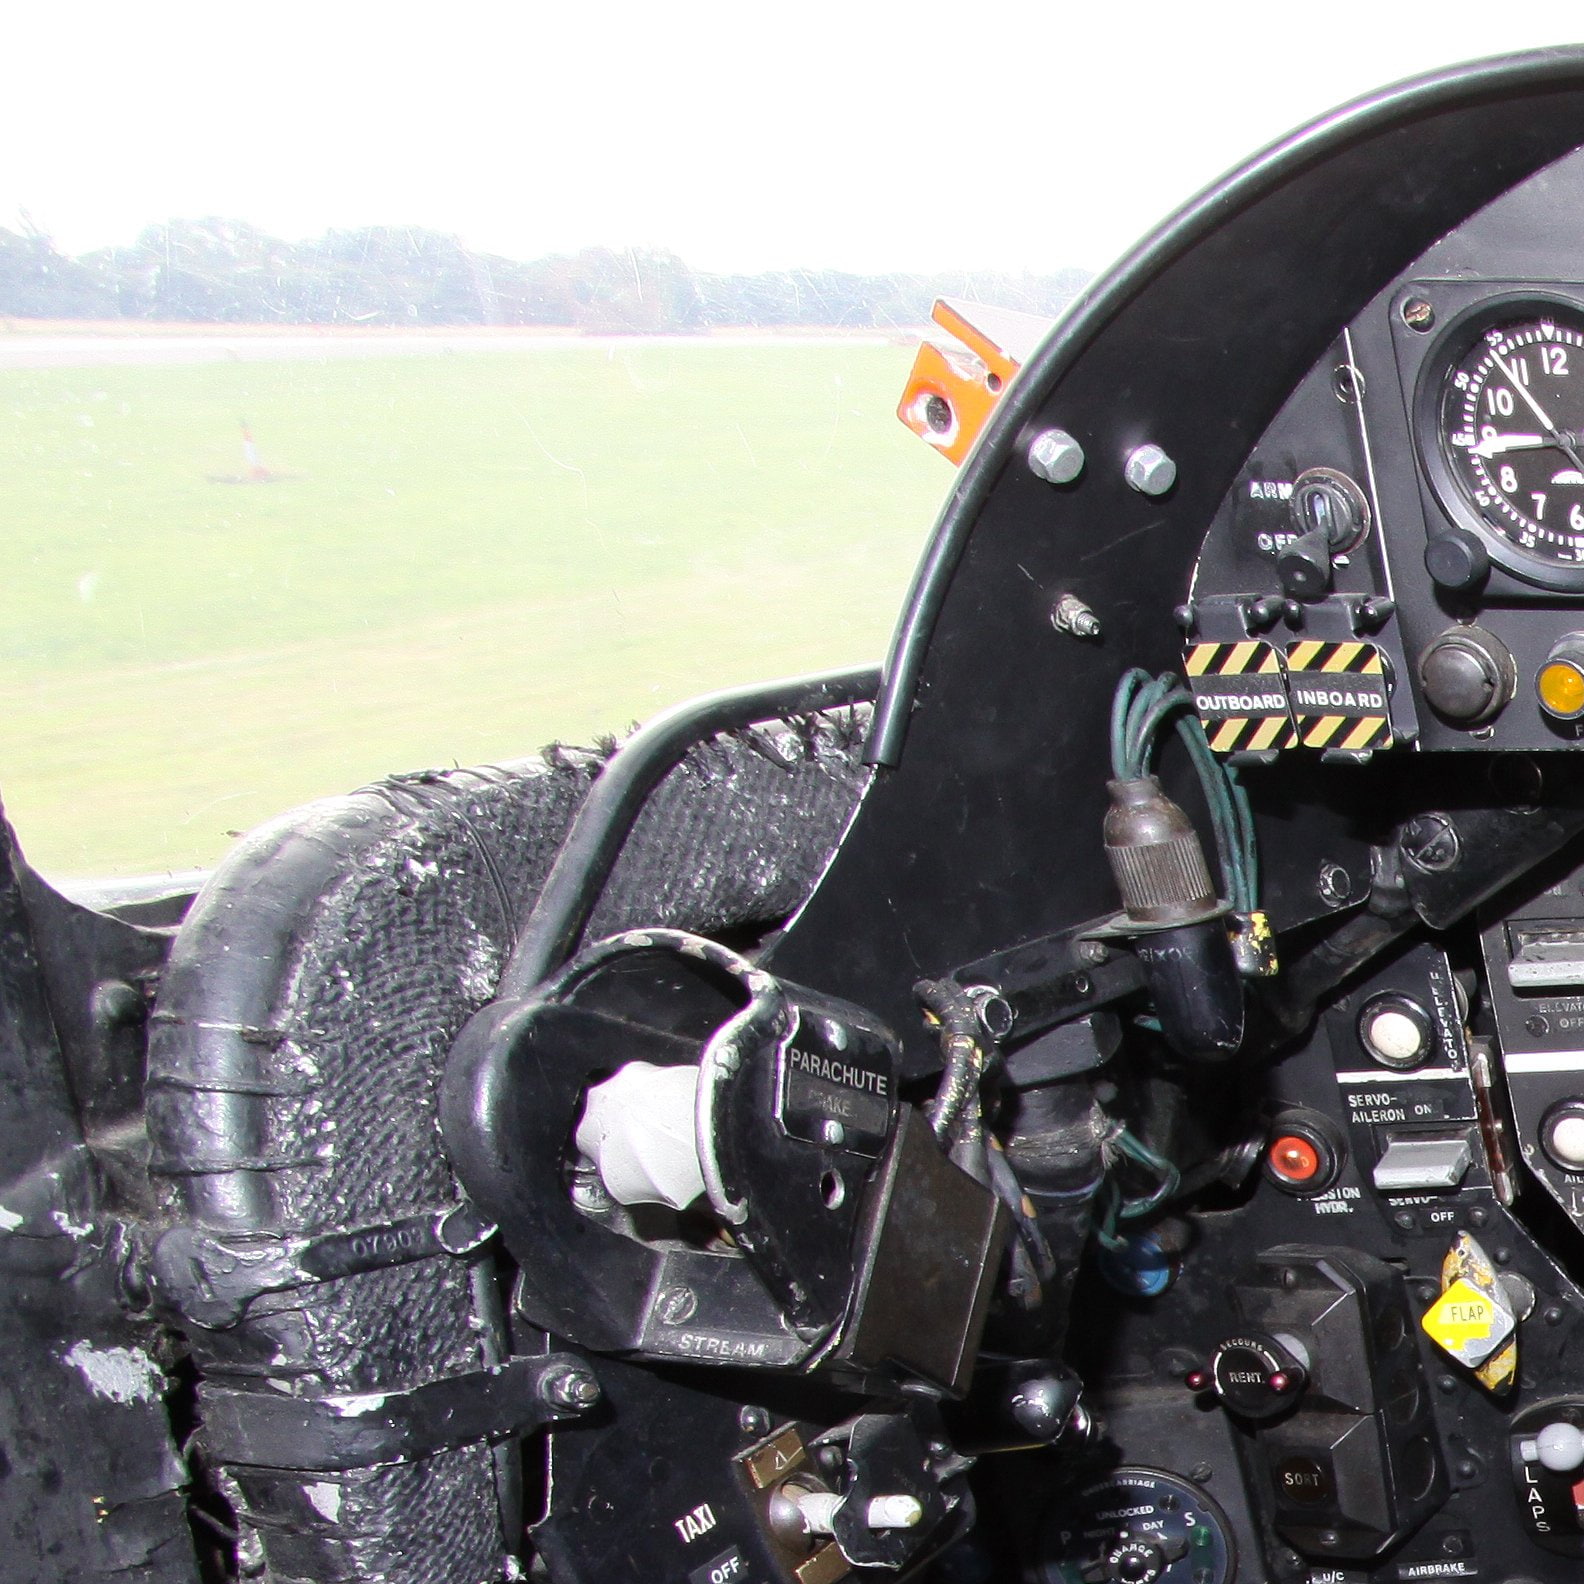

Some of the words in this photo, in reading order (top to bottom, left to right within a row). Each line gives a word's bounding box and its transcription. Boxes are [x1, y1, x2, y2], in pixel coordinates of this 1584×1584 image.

[1195, 693, 1287, 711] OUTBOARD
[1296, 690, 1383, 710] INBOARD
[789, 1048, 888, 1095] PARACHUTE
[1351, 1108, 1406, 1124] AILERON
[1430, 1211, 1455, 1224] OFF
[1449, 1304, 1486, 1322] FLAP
[677, 1333, 766, 1358] STREAM
[1284, 1471, 1320, 1487] SORT
[674, 1503, 717, 1544] TAXI
[1407, 1561, 1466, 1577] AIRBRAKE
